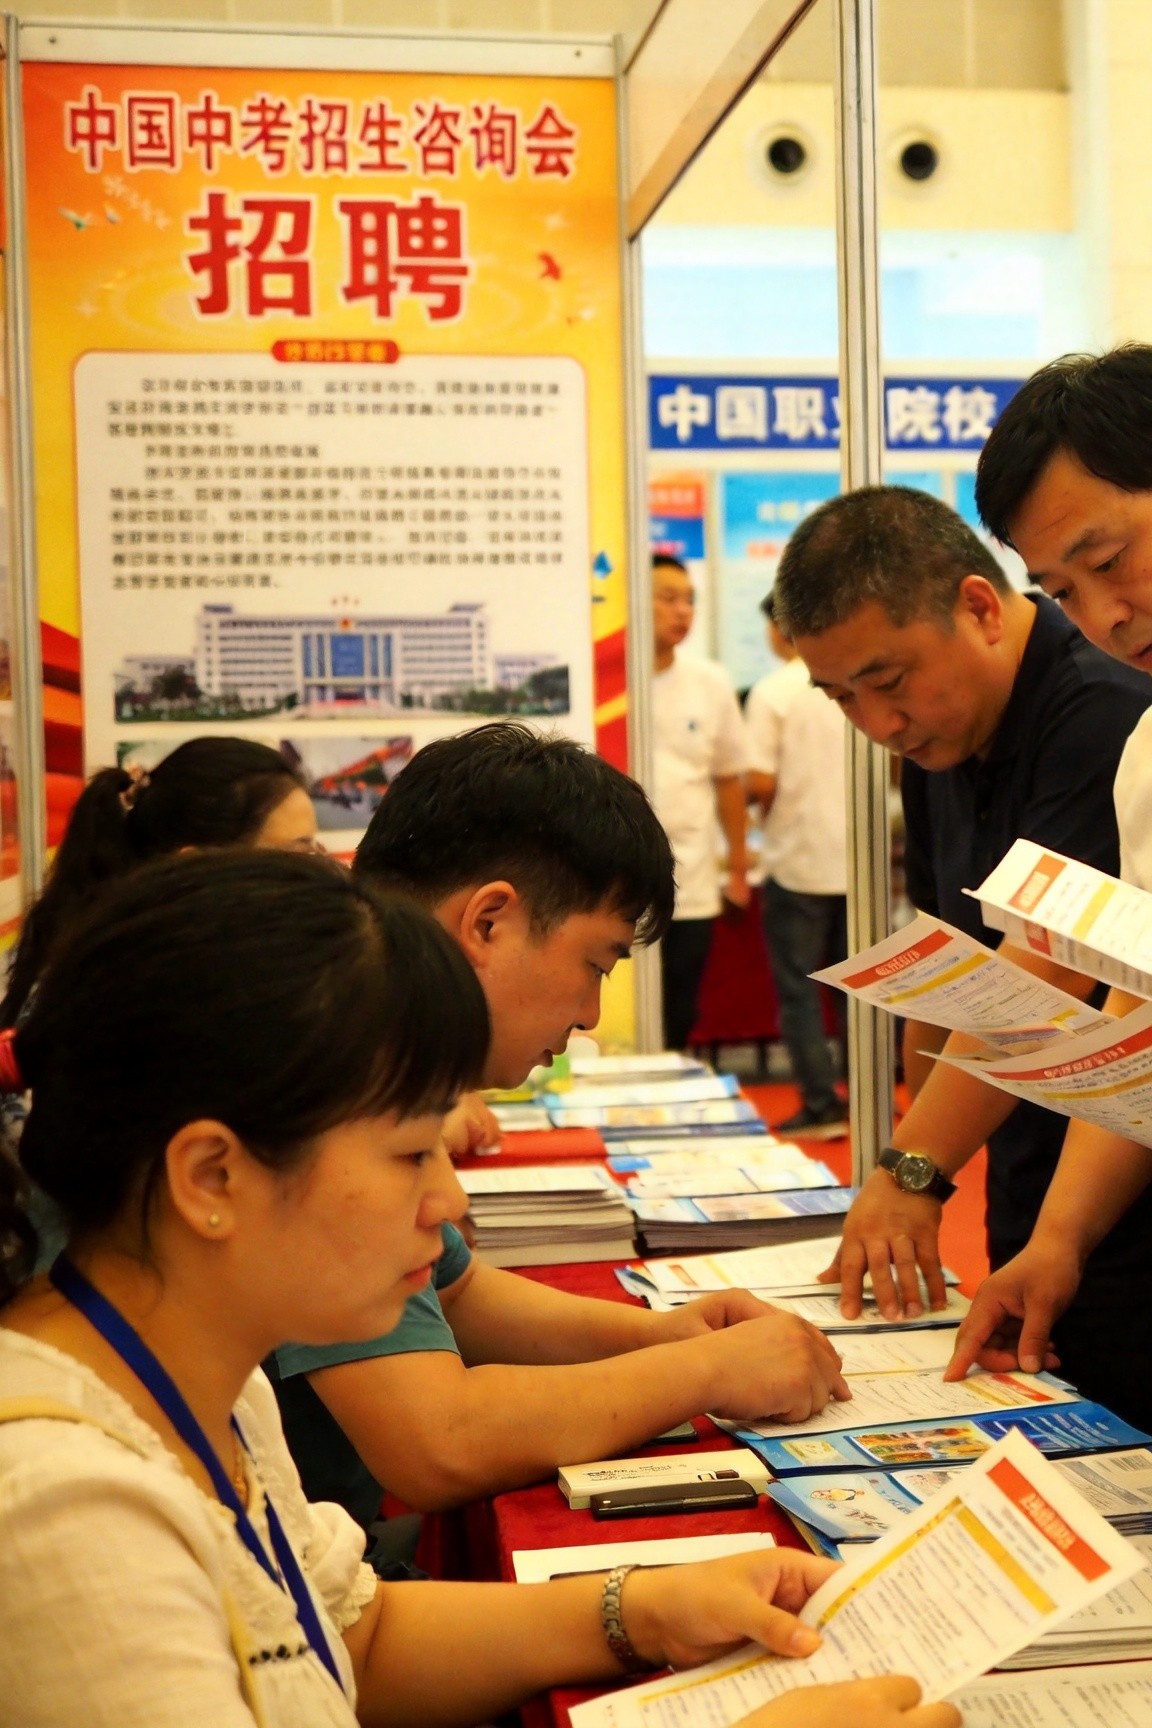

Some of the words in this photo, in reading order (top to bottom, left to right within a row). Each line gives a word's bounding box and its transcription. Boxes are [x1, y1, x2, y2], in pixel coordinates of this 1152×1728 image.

[70, 91, 576, 178] 中国中考招生咨询会
[187, 192, 470, 321] 招聘
[657, 383, 998, 443] 中国职院校
